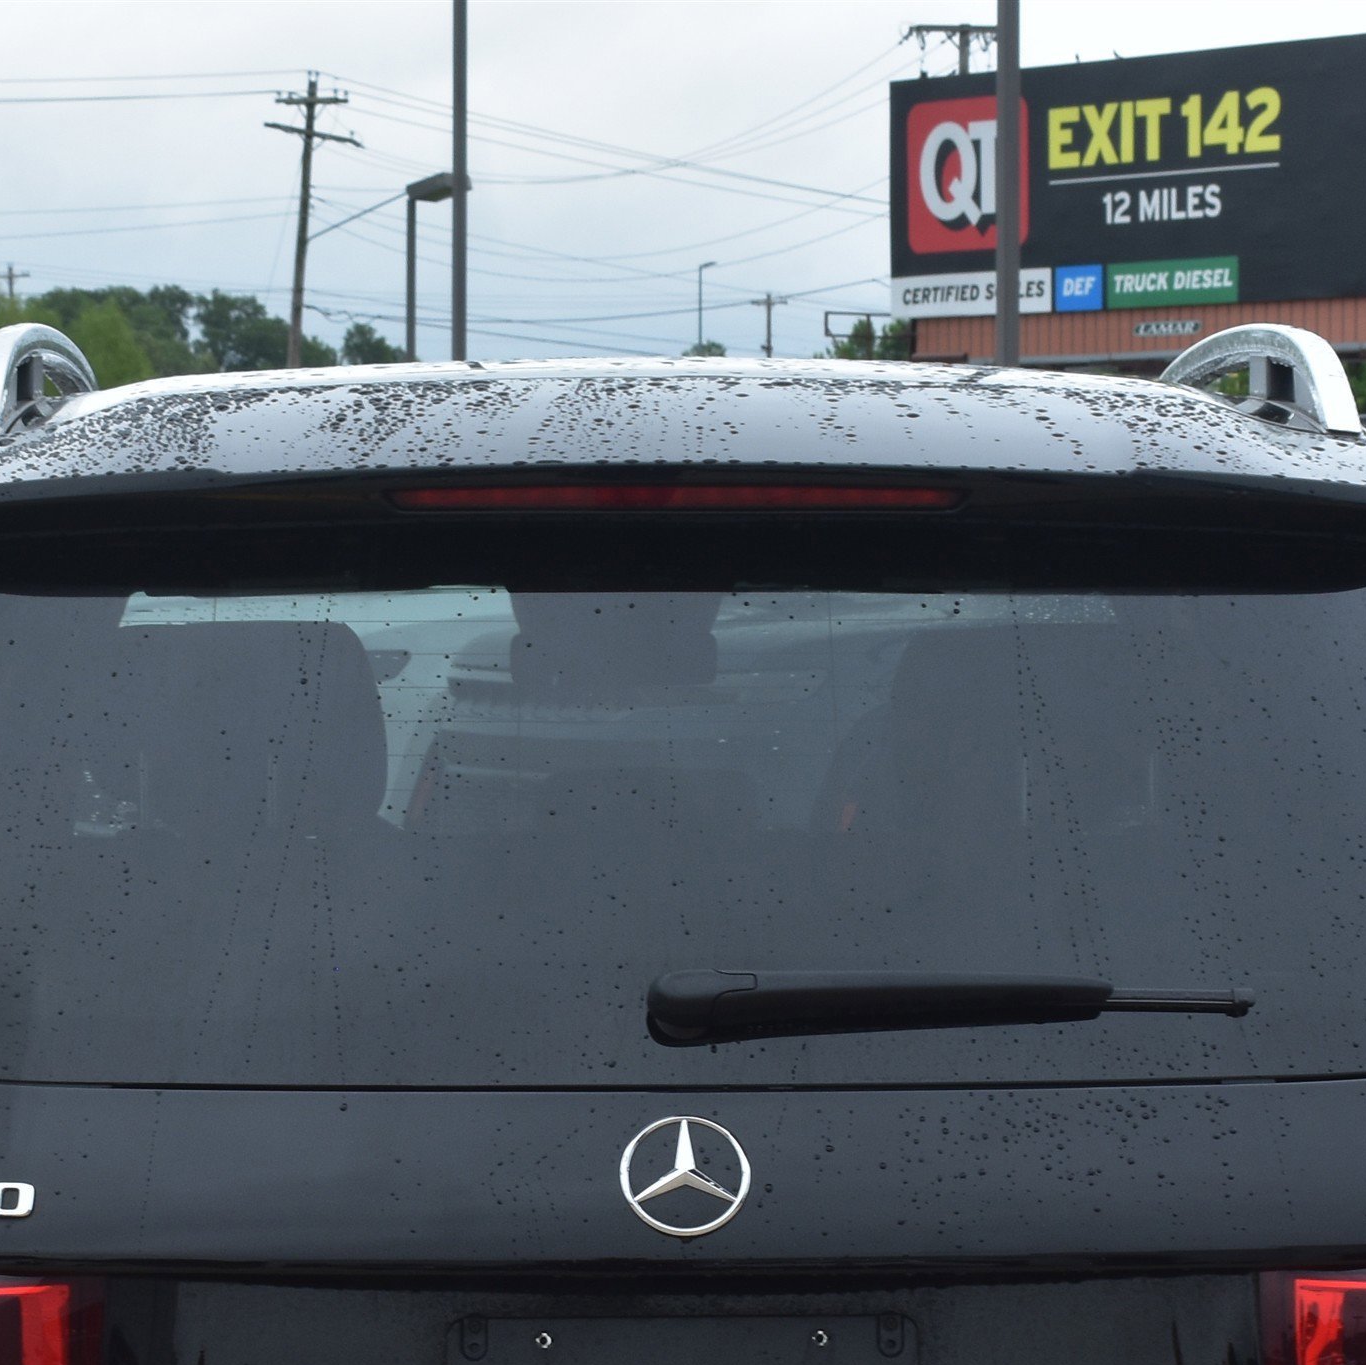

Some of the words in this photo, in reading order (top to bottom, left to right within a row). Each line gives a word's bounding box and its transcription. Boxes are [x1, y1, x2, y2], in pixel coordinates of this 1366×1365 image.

[1048, 97, 1172, 170] EXIT
[1180, 86, 1282, 159] 142
[1102, 190, 1132, 225] 12
[1138, 183, 1223, 223] MILES
[902, 284, 981, 306] CERTIFIED
[985, 280, 1046, 301] SES
[1062, 275, 1096, 297] DEF
[1113, 271, 1170, 294] TRUCK
[1172, 267, 1234, 291] DIESEL
[1138, 321, 1196, 336] LAMAR
